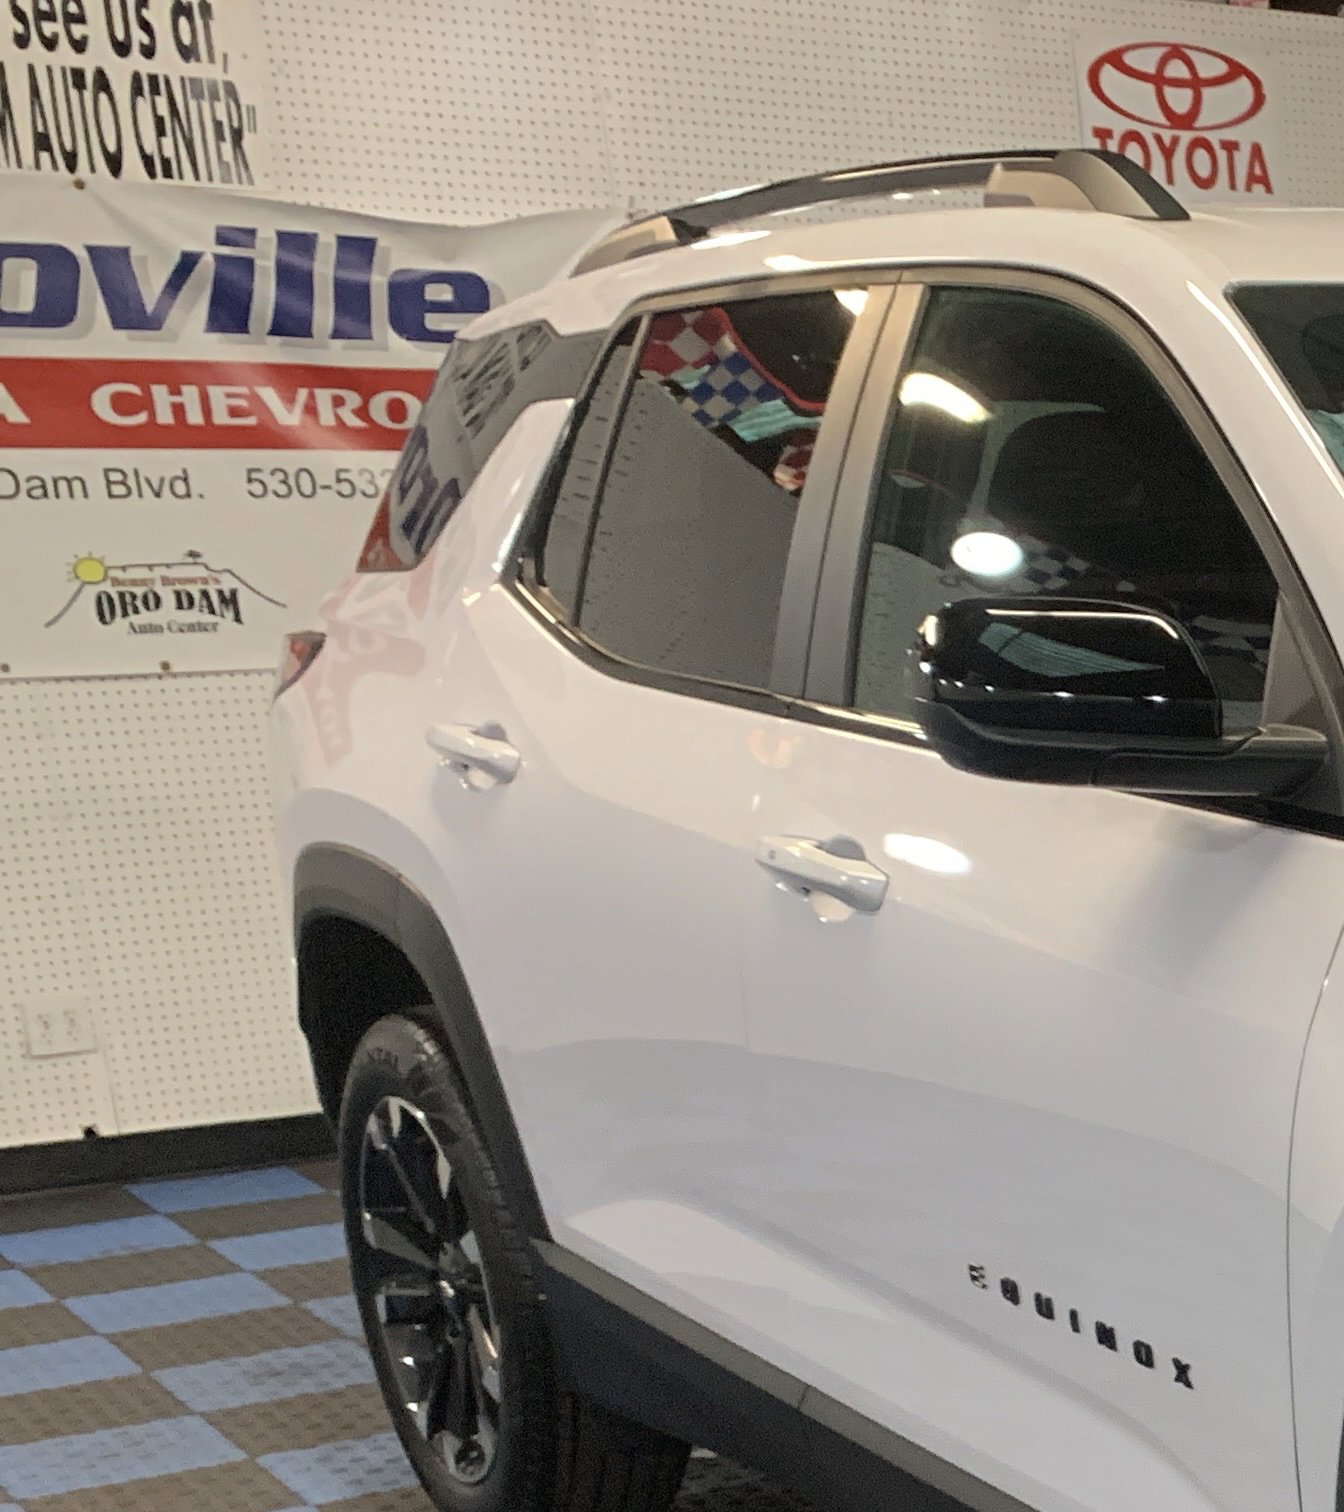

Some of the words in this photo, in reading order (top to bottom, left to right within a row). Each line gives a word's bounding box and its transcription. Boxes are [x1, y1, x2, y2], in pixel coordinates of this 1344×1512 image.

[10, 0, 89, 55] see
[104, 0, 156, 60] us
[28, 63, 123, 180] AUTO
[102, 467, 204, 500] Blvd.
[95, 589, 163, 626] ORO
[173, 587, 244, 625] DAM
[127, 621, 164, 635] Auto
[167, 619, 219, 634] Center
[968, 1263, 1194, 1390] EQUINOX
